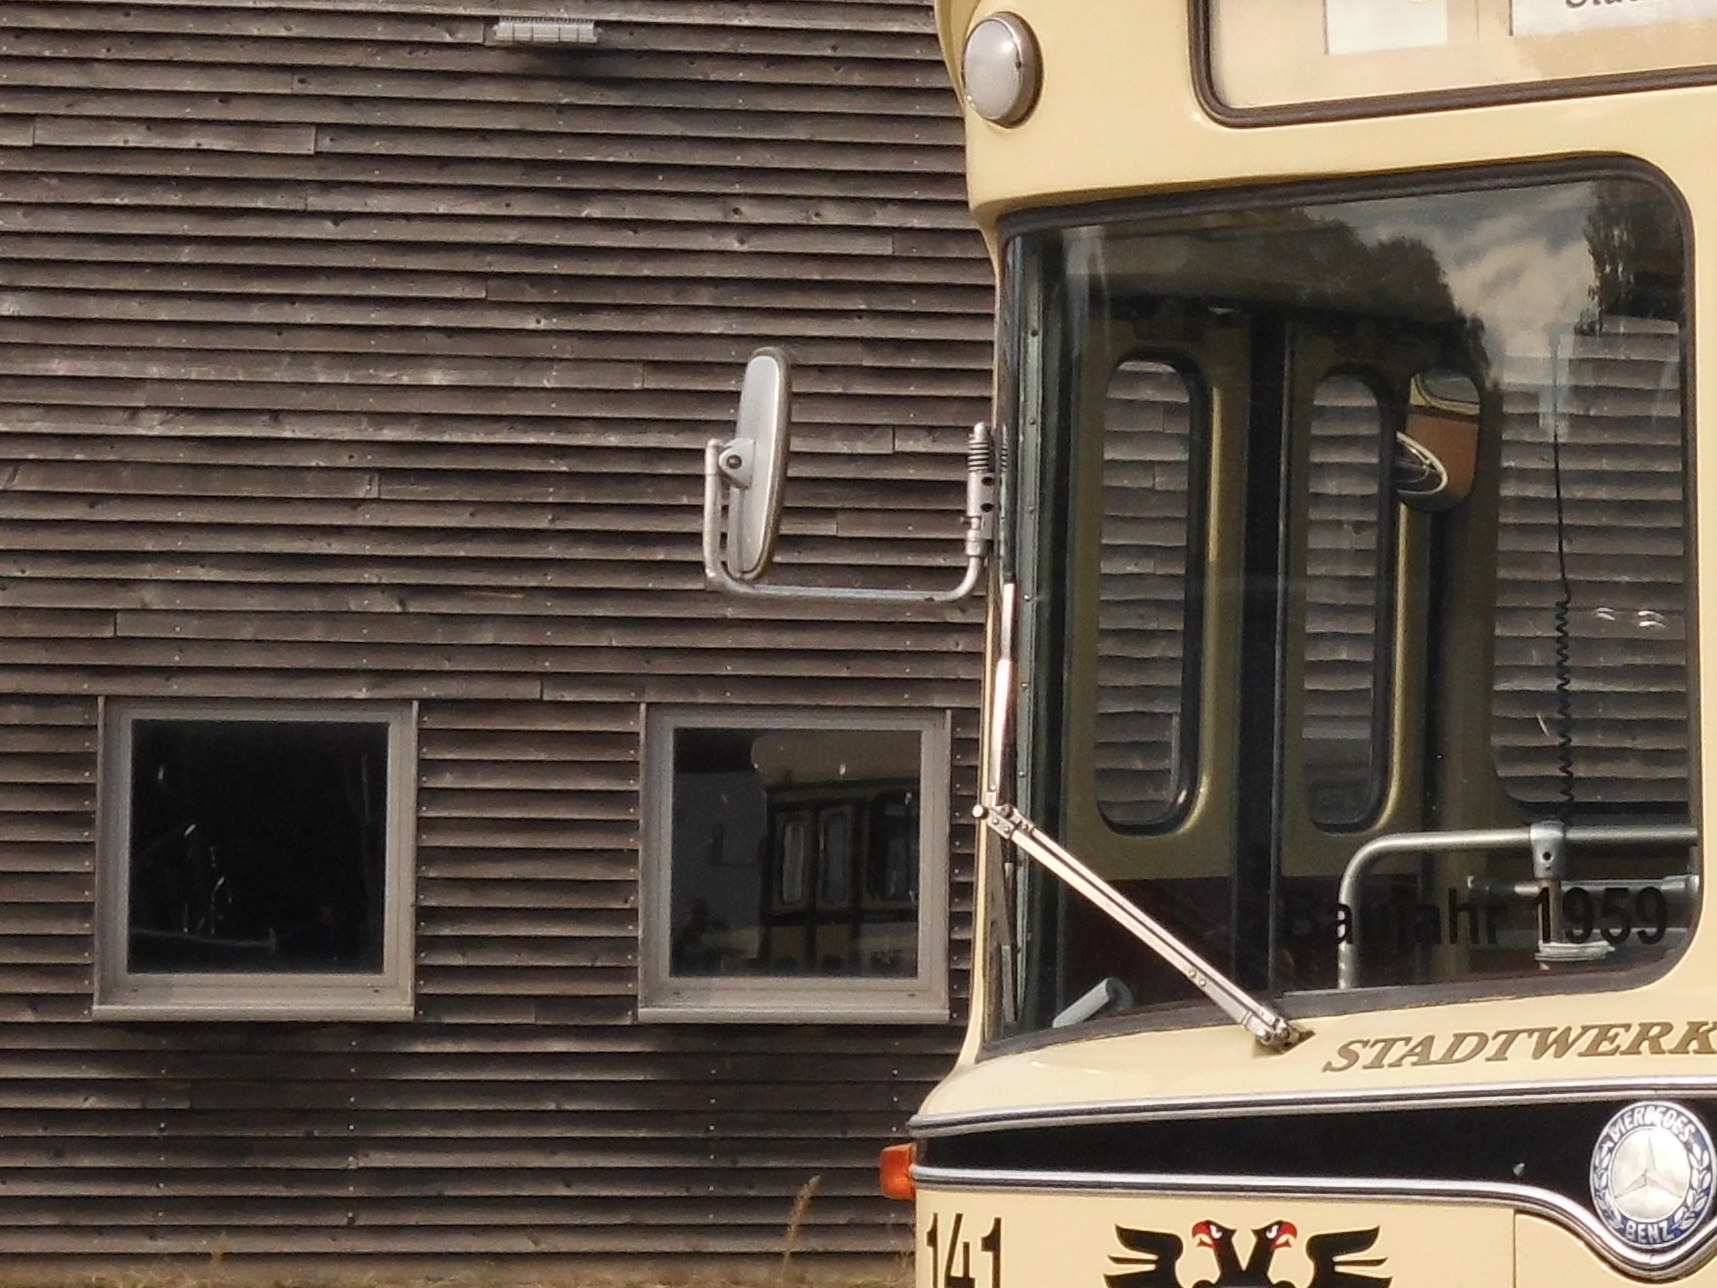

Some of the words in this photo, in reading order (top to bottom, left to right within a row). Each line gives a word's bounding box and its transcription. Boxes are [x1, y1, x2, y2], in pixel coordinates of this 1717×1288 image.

[1531, 884, 1668, 946] 1959
[1607, 1106, 1695, 1143] MERCEDES
[1625, 1220, 1675, 1243] BENZ
